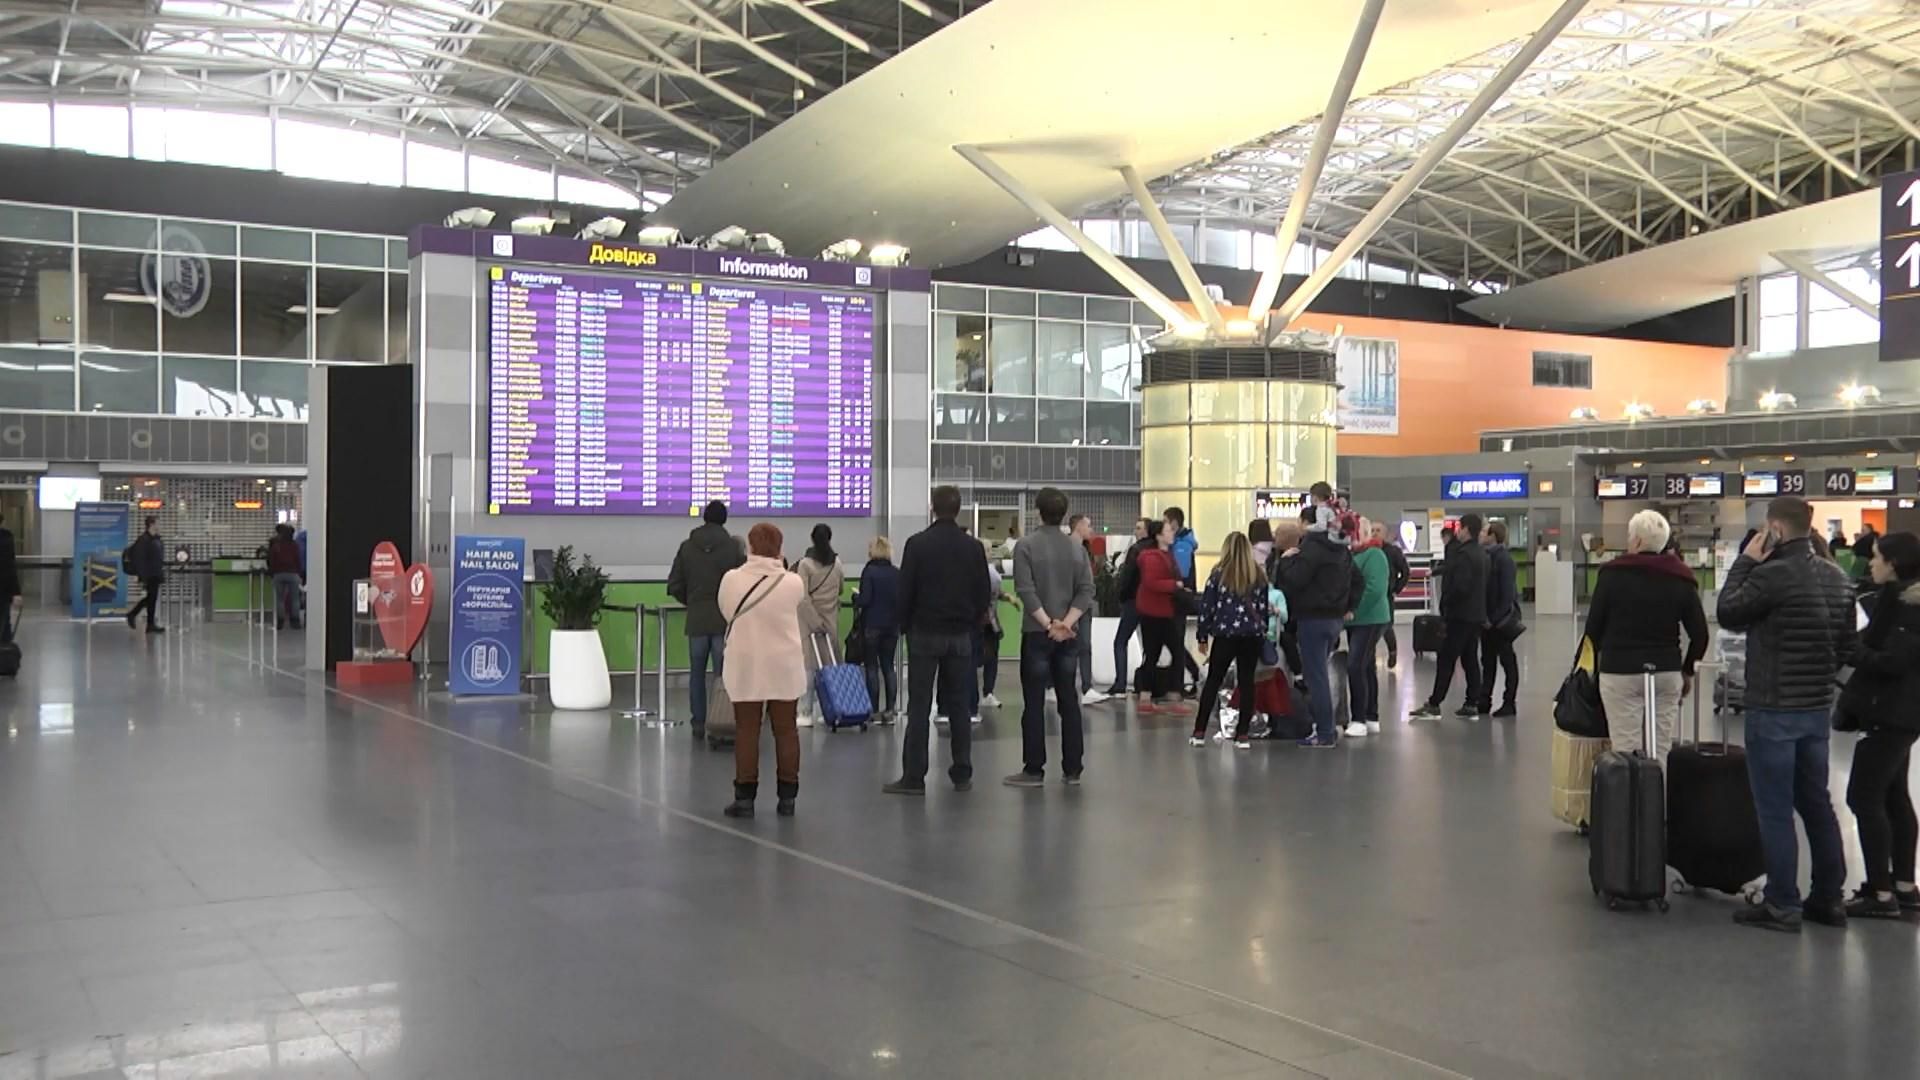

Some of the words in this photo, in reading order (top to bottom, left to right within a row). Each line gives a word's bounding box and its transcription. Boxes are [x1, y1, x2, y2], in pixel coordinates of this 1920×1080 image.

[589, 244, 657, 267] Довідка
[719, 256, 808, 281] Information
[510, 270, 563, 285] Departures
[709, 286, 756, 300] Departures
[1462, 480, 1488, 493] MTB
[1488, 479, 1522, 493] BANK
[1630, 479, 1648, 495] 37
[1666, 478, 1685, 494] 38
[1783, 475, 1804, 492] 39
[1827, 473, 1850, 491] 40
[466, 549, 490, 559] HAIR
[492, 550, 514, 560] AND
[460, 560, 484, 570] NAIL
[485, 561, 519, 571] SALON
